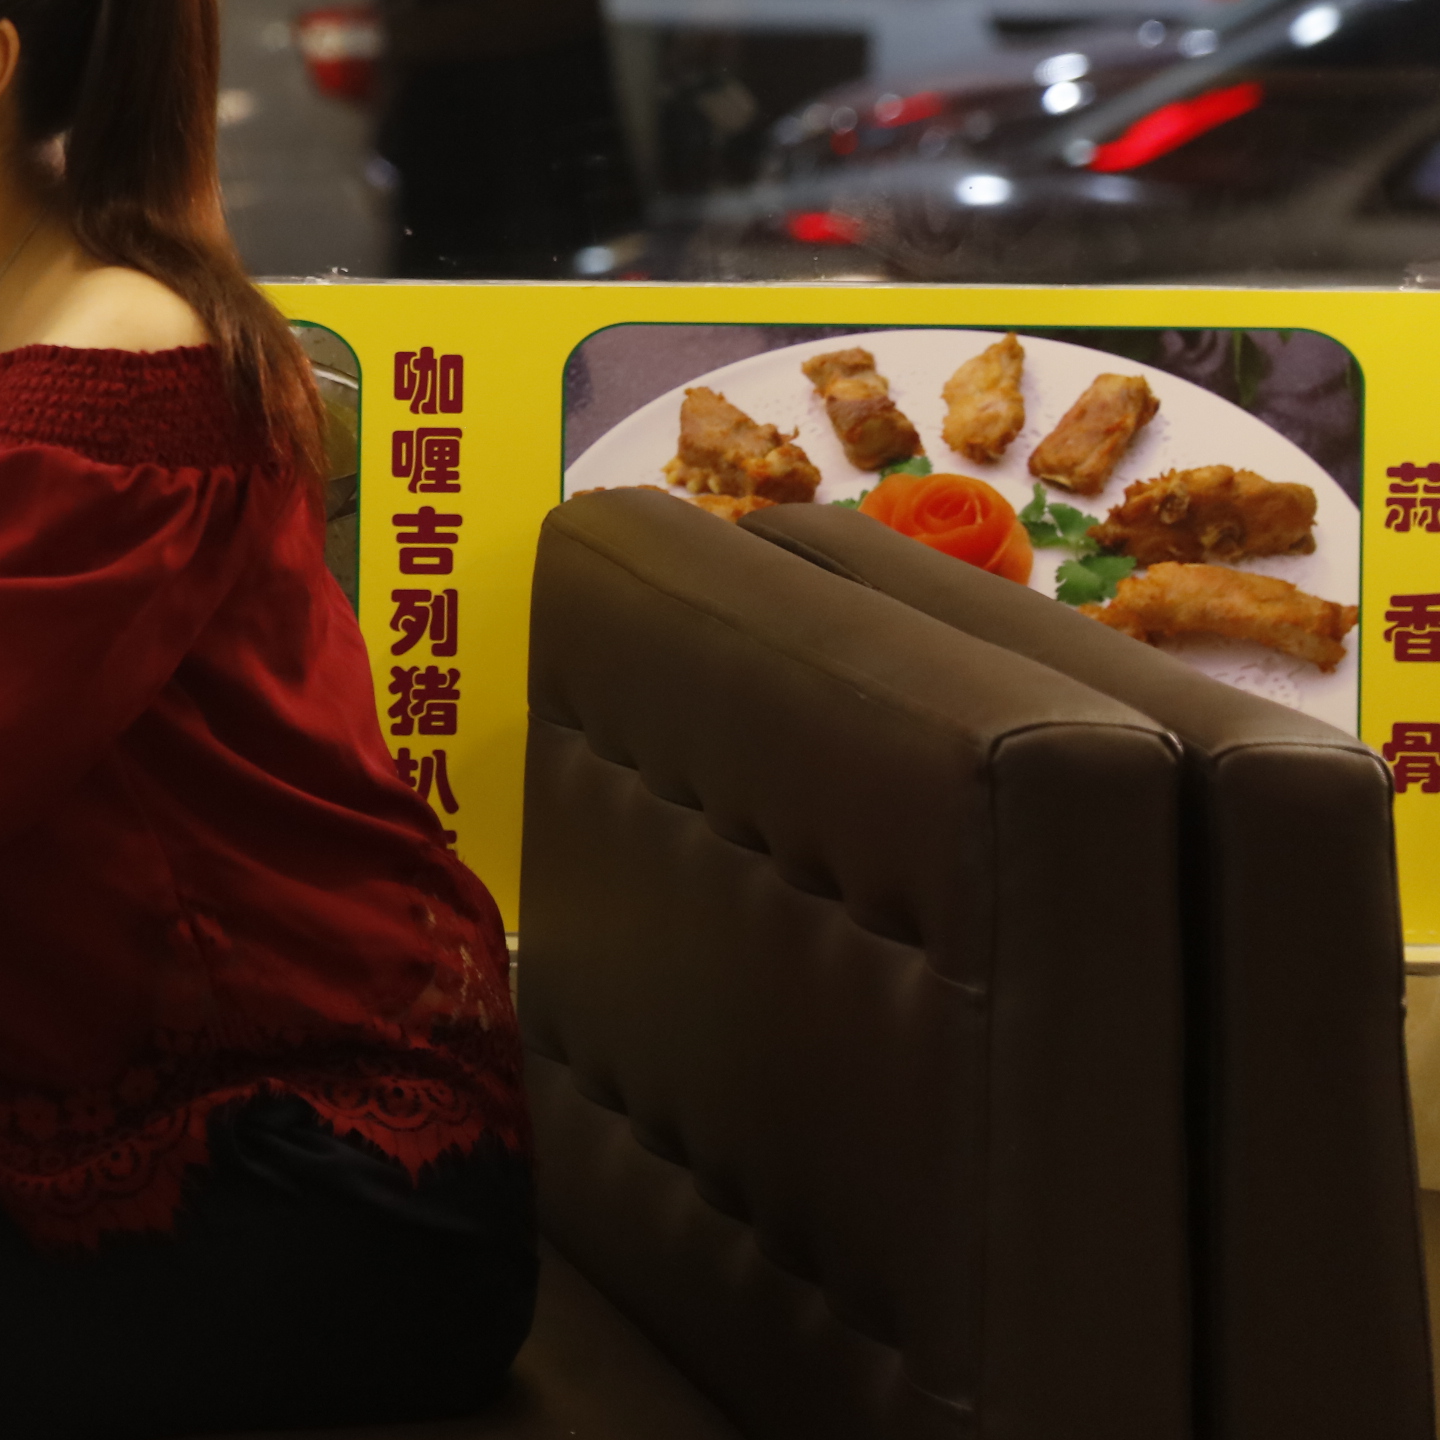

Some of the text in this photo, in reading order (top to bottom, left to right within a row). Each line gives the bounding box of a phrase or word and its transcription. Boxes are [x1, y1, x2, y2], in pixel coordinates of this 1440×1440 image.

[387, 346, 465, 859] 咖喱吉列猪扒
